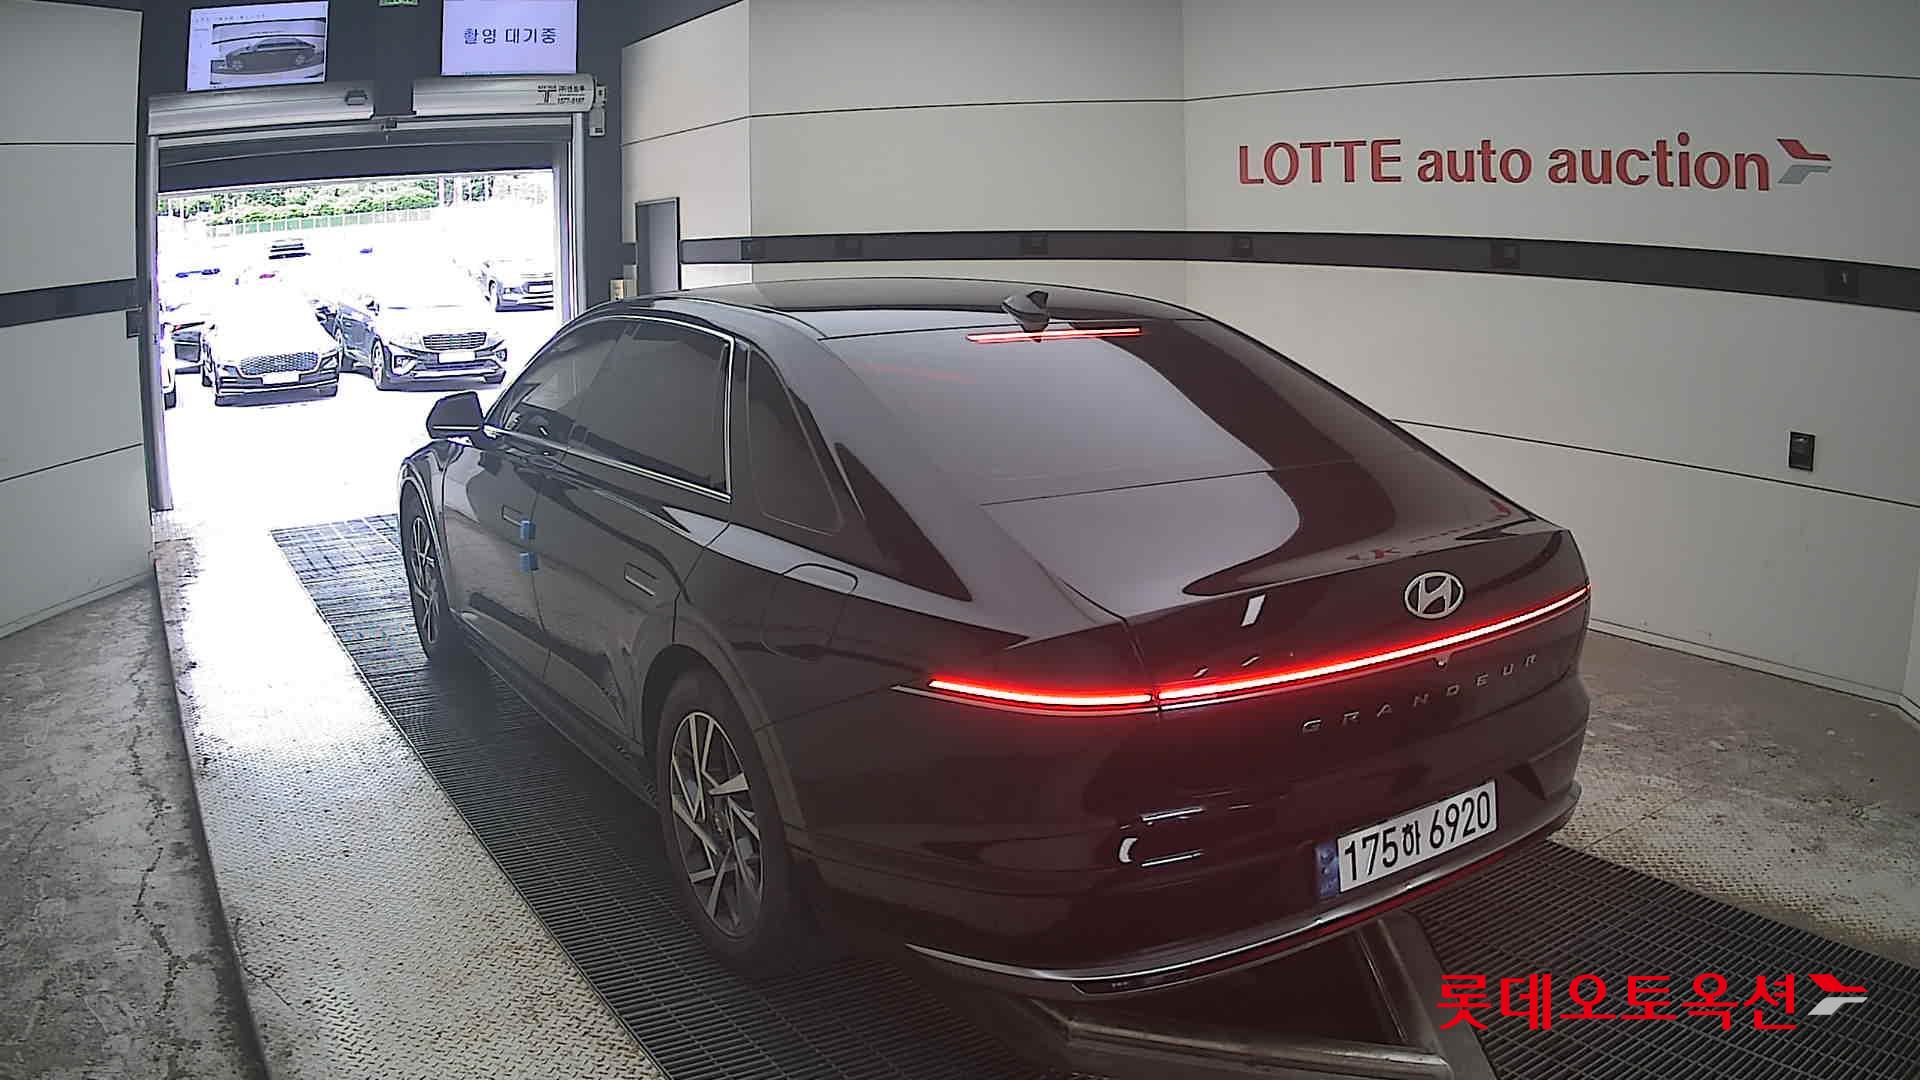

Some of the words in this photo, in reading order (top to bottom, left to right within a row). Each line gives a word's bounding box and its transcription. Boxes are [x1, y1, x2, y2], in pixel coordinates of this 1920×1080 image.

[505, 28, 557, 44] 대기중
[1239, 139, 1401, 185] LOTTE
[1417, 139, 1532, 184] auto
[1548, 132, 1770, 191] auction
[1302, 653, 1538, 733] GRANDEUR
[1344, 820, 1421, 881] 175하
[1429, 791, 1491, 849] 6920
